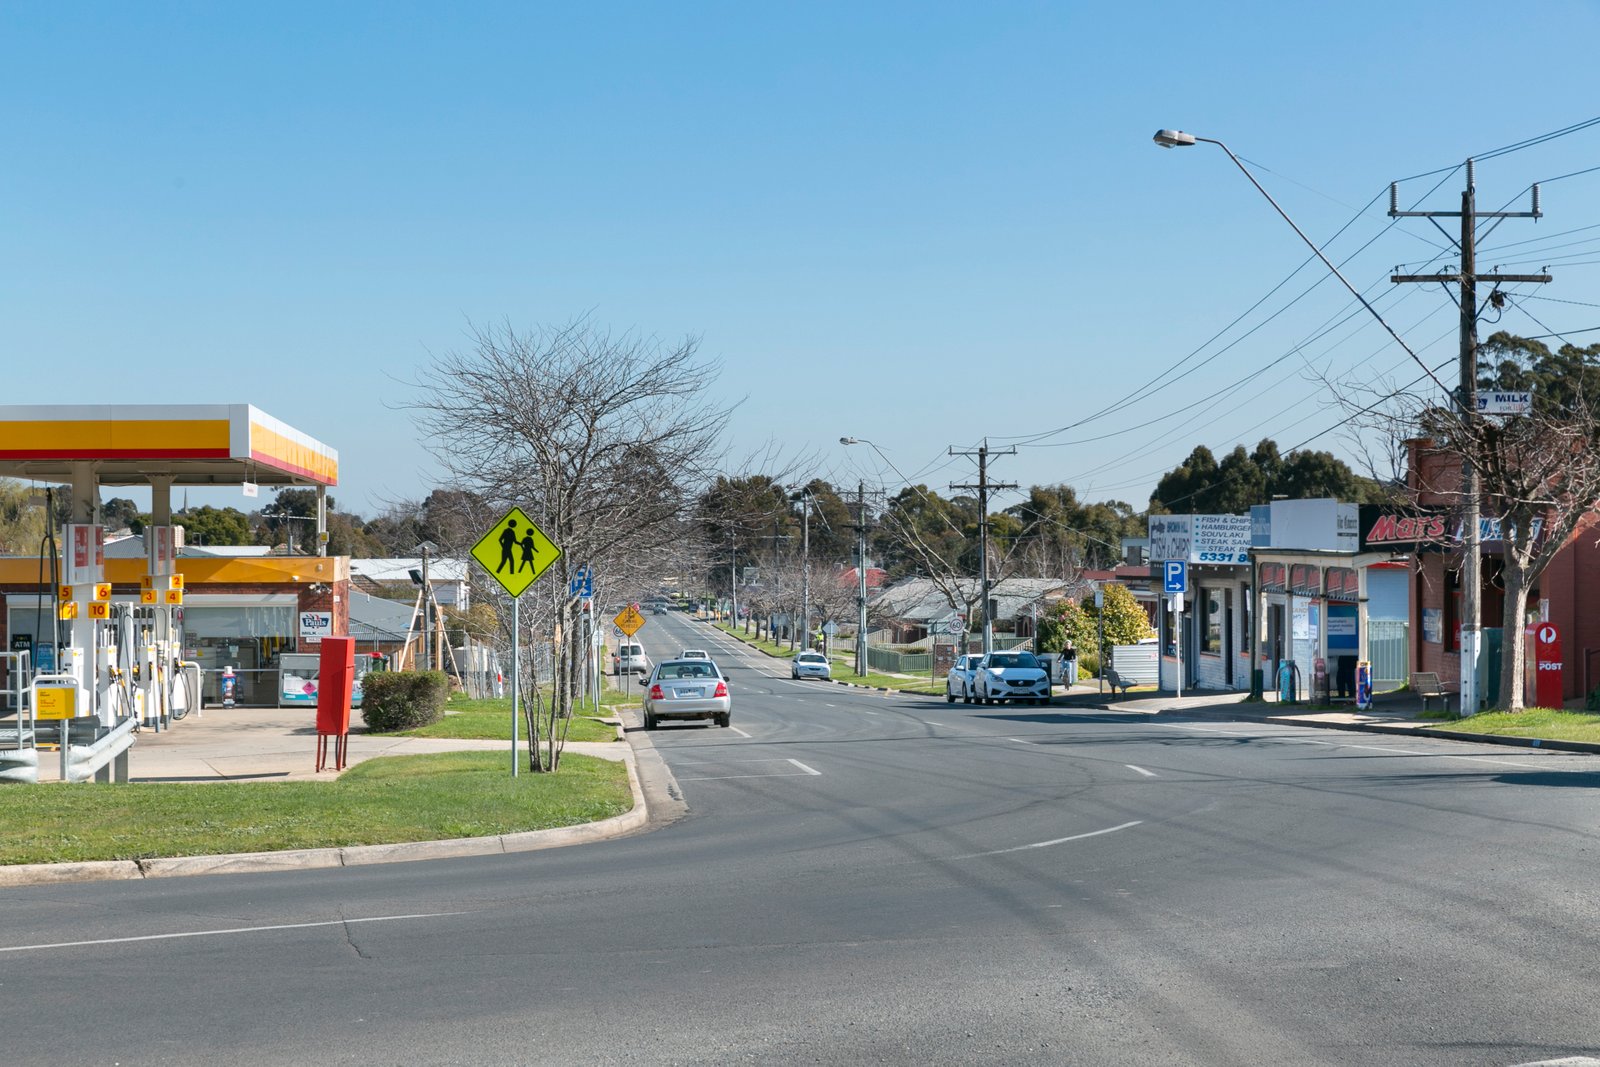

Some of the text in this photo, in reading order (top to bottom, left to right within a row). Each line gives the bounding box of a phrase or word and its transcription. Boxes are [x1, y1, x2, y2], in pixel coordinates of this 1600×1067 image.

[1495, 394, 1528, 402] MILK
[1366, 514, 1445, 542] Mars
[1200, 530, 1244, 538] SOUVLAKI
[1171, 538, 1190, 560] CHIPS
[1199, 552, 1233, 562] 5331
[1168, 562, 1182, 582] P
[174, 577, 180, 585] 2
[62, 588, 69, 597] 5
[100, 588, 107, 597] 6
[146, 592, 152, 600] 3
[169, 592, 176, 600] 4
[92, 605, 104, 615] 10
[305, 618, 327, 626] Pauls
[1539, 663, 1563, 671] POST
